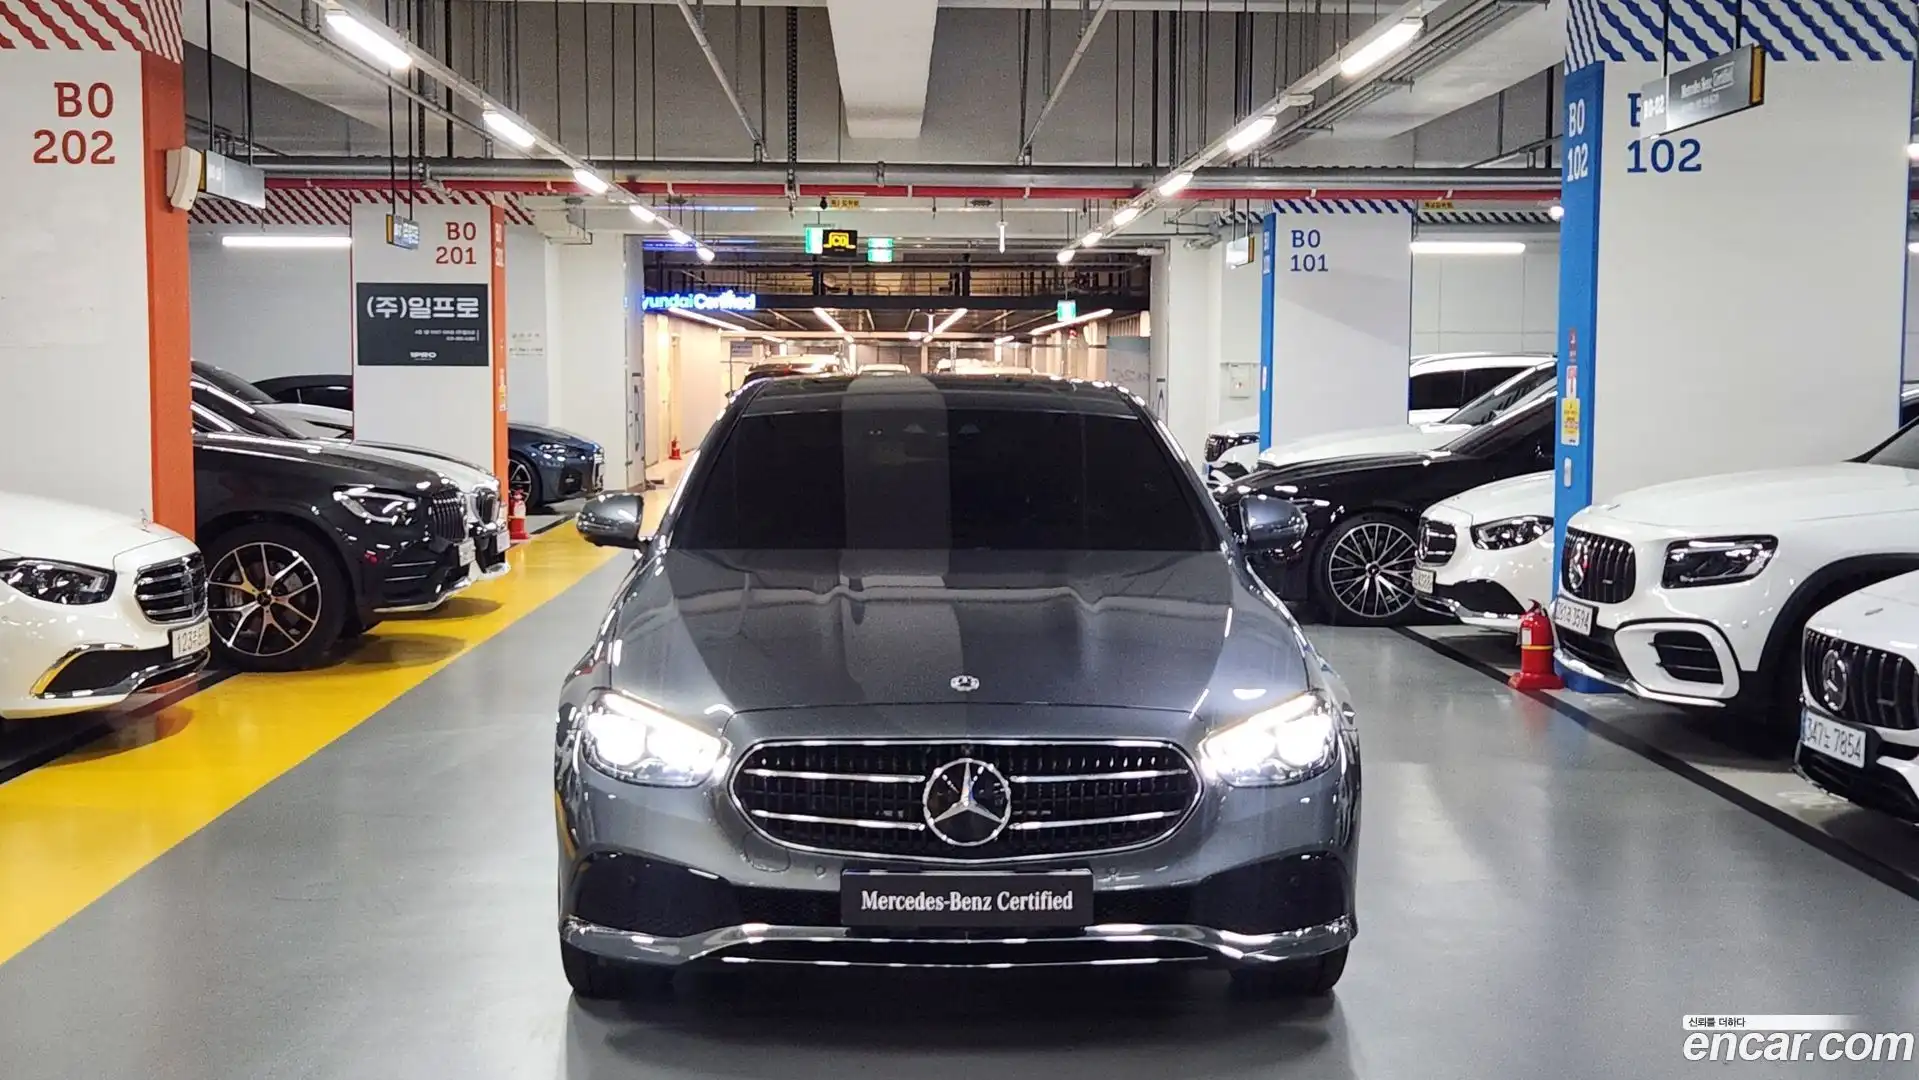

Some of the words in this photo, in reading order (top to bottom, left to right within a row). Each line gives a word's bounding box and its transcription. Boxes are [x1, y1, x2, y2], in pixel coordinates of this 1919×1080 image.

[33, 129, 116, 164] 202
[1627, 139, 1702, 173] 102
[1567, 142, 1589, 182] 102
[436, 246, 477, 265] 201
[1290, 254, 1329, 272] 101
[366, 296, 479, 319] (주)일프로
[1834, 727, 1862, 761] 7854
[861, 890, 992, 911] Mercedes-Benz
[996, 890, 1074, 911] Certified
